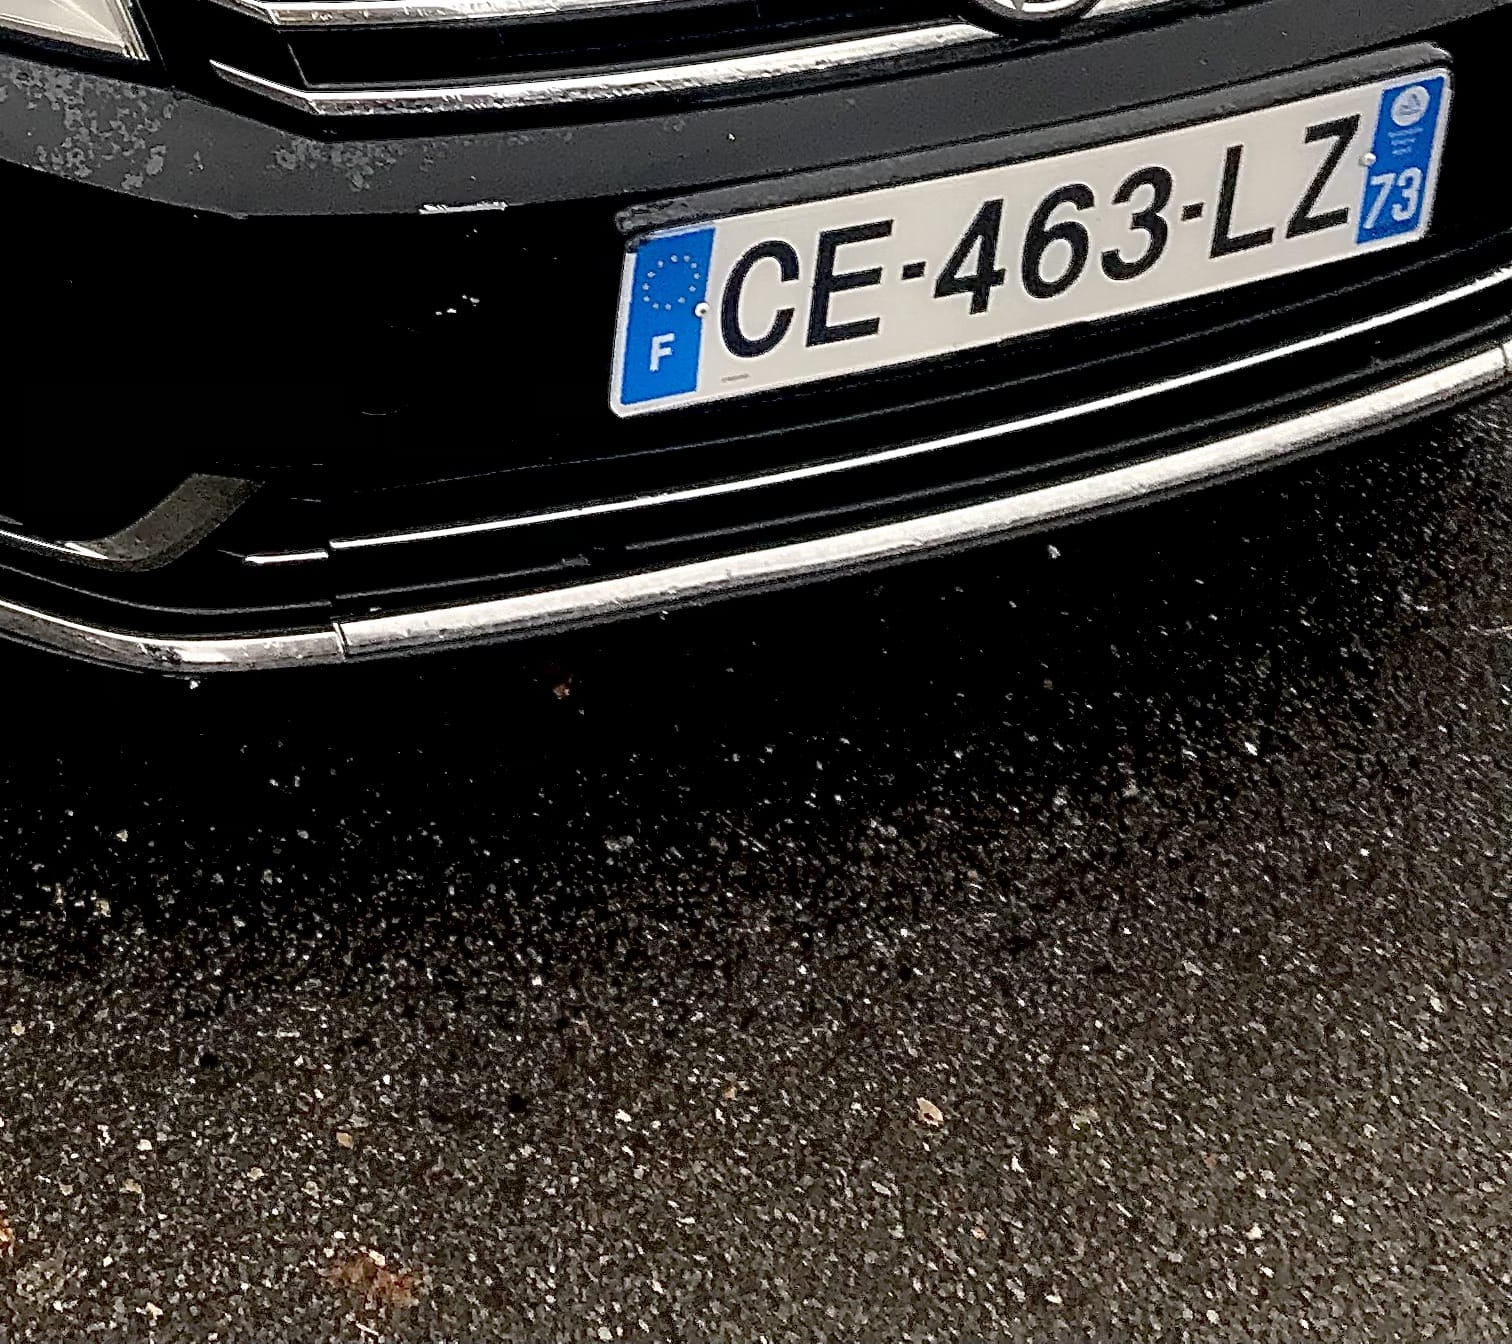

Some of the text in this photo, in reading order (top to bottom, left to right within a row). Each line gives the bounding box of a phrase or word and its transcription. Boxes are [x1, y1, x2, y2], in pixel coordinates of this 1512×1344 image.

[1363, 166, 1423, 229] 73
[718, 113, 1361, 358] CE-463-LZ
[649, 333, 675, 372] F
